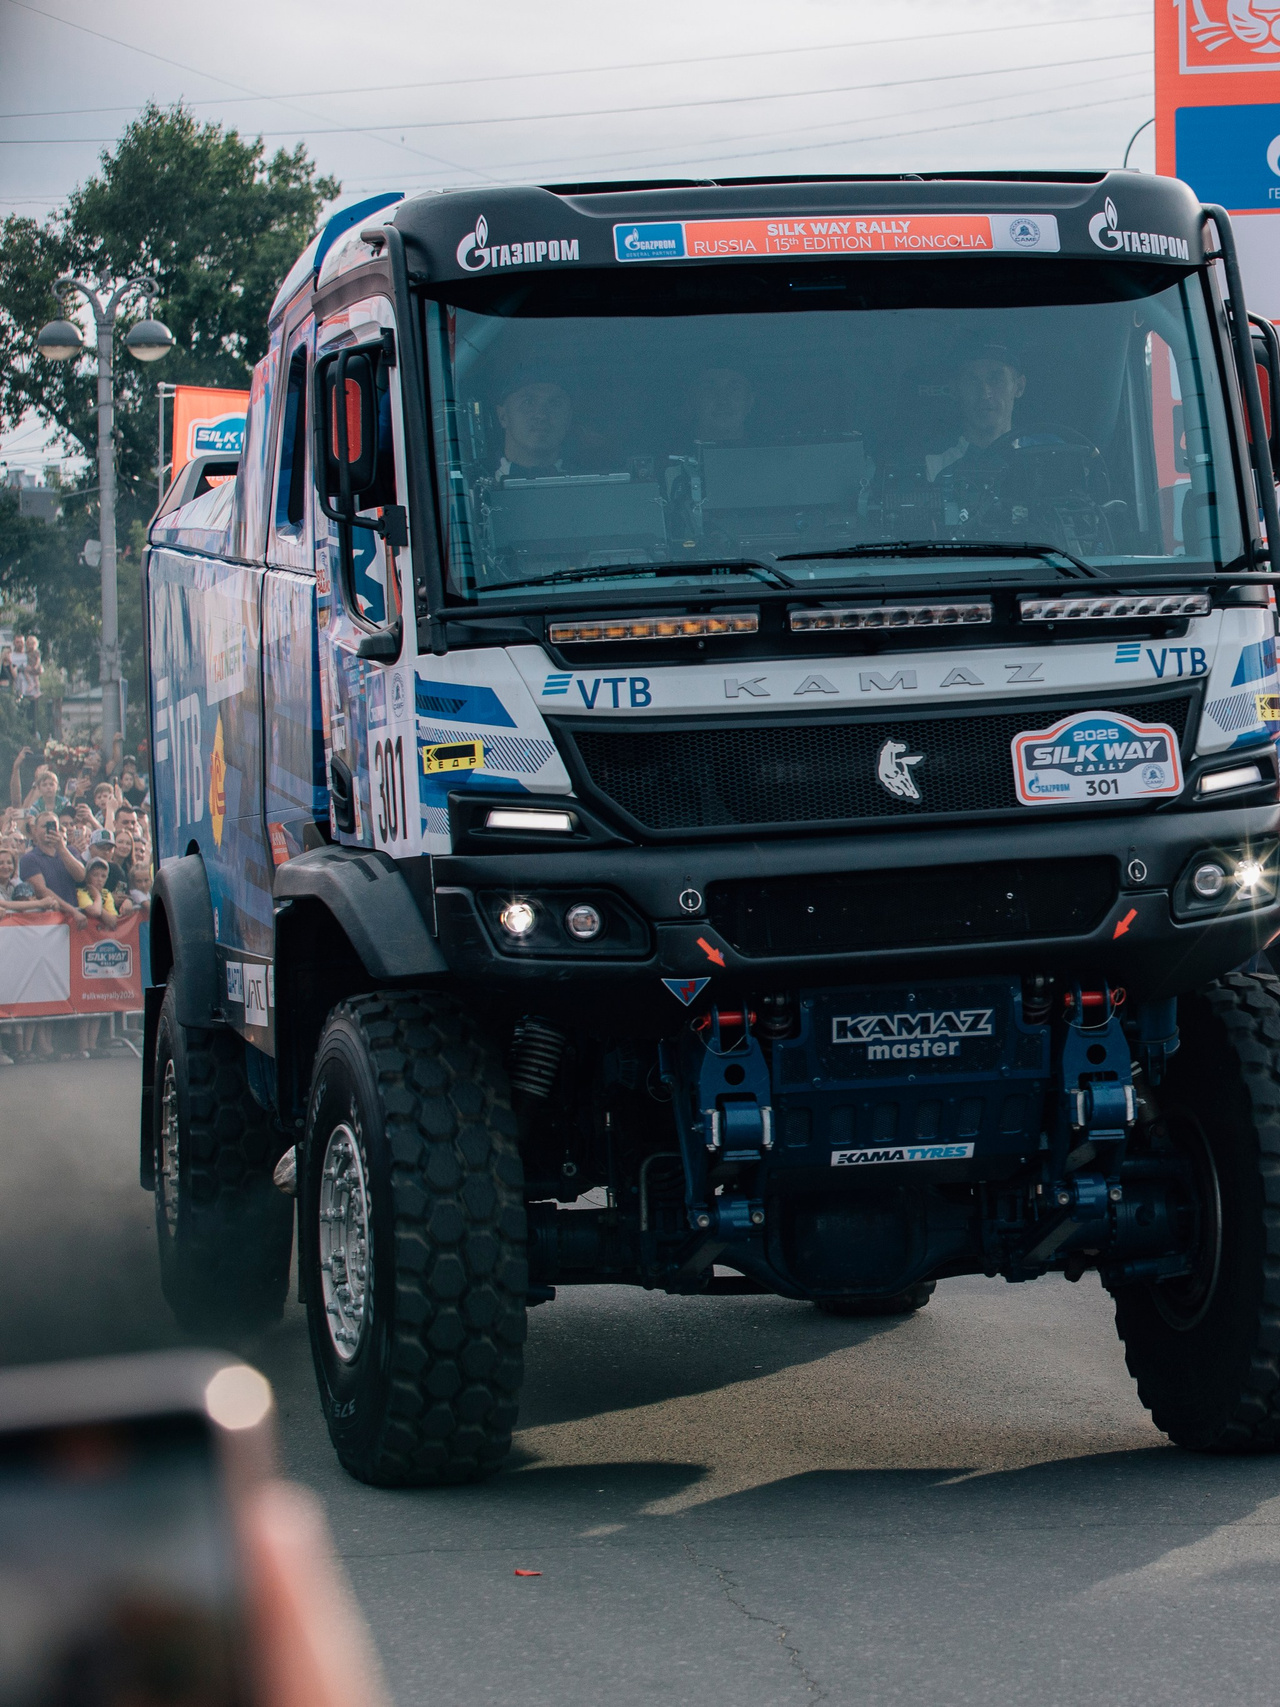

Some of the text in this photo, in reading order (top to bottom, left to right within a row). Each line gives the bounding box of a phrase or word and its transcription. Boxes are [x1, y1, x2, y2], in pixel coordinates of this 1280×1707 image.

[767, 221, 911, 236] SILK WAY RALLY
[640, 240, 676, 250] GAZPROM
[694, 234, 987, 254] RUSSIA 15th EDITION MONGOLIA
[1123, 231, 1190, 261] ГАЗПРОМ
[491, 239, 580, 268] ГАЗПРОМ
[197, 429, 239, 443] SILK
[1146, 647, 1207, 678] VTB
[724, 662, 1046, 698] KAMAZ
[577, 677, 652, 709] VTB
[1260, 710, 1280, 718] КЕ
[1073, 728, 1119, 742] 2025
[168, 692, 204, 828] VTB
[1032, 740, 1161, 766] SILK WAY
[426, 757, 477, 771] КЕДР
[1074, 762, 1126, 773] RALLY
[375, 735, 408, 844] 301
[1040, 783, 1071, 793] GAZPROM
[1085, 779, 1119, 796] 301
[87, 951, 127, 961] SILK WAY
[832, 1009, 993, 1043] KAMAZ
[868, 1039, 960, 1060] master
[907, 1146, 968, 1160] TYRES
